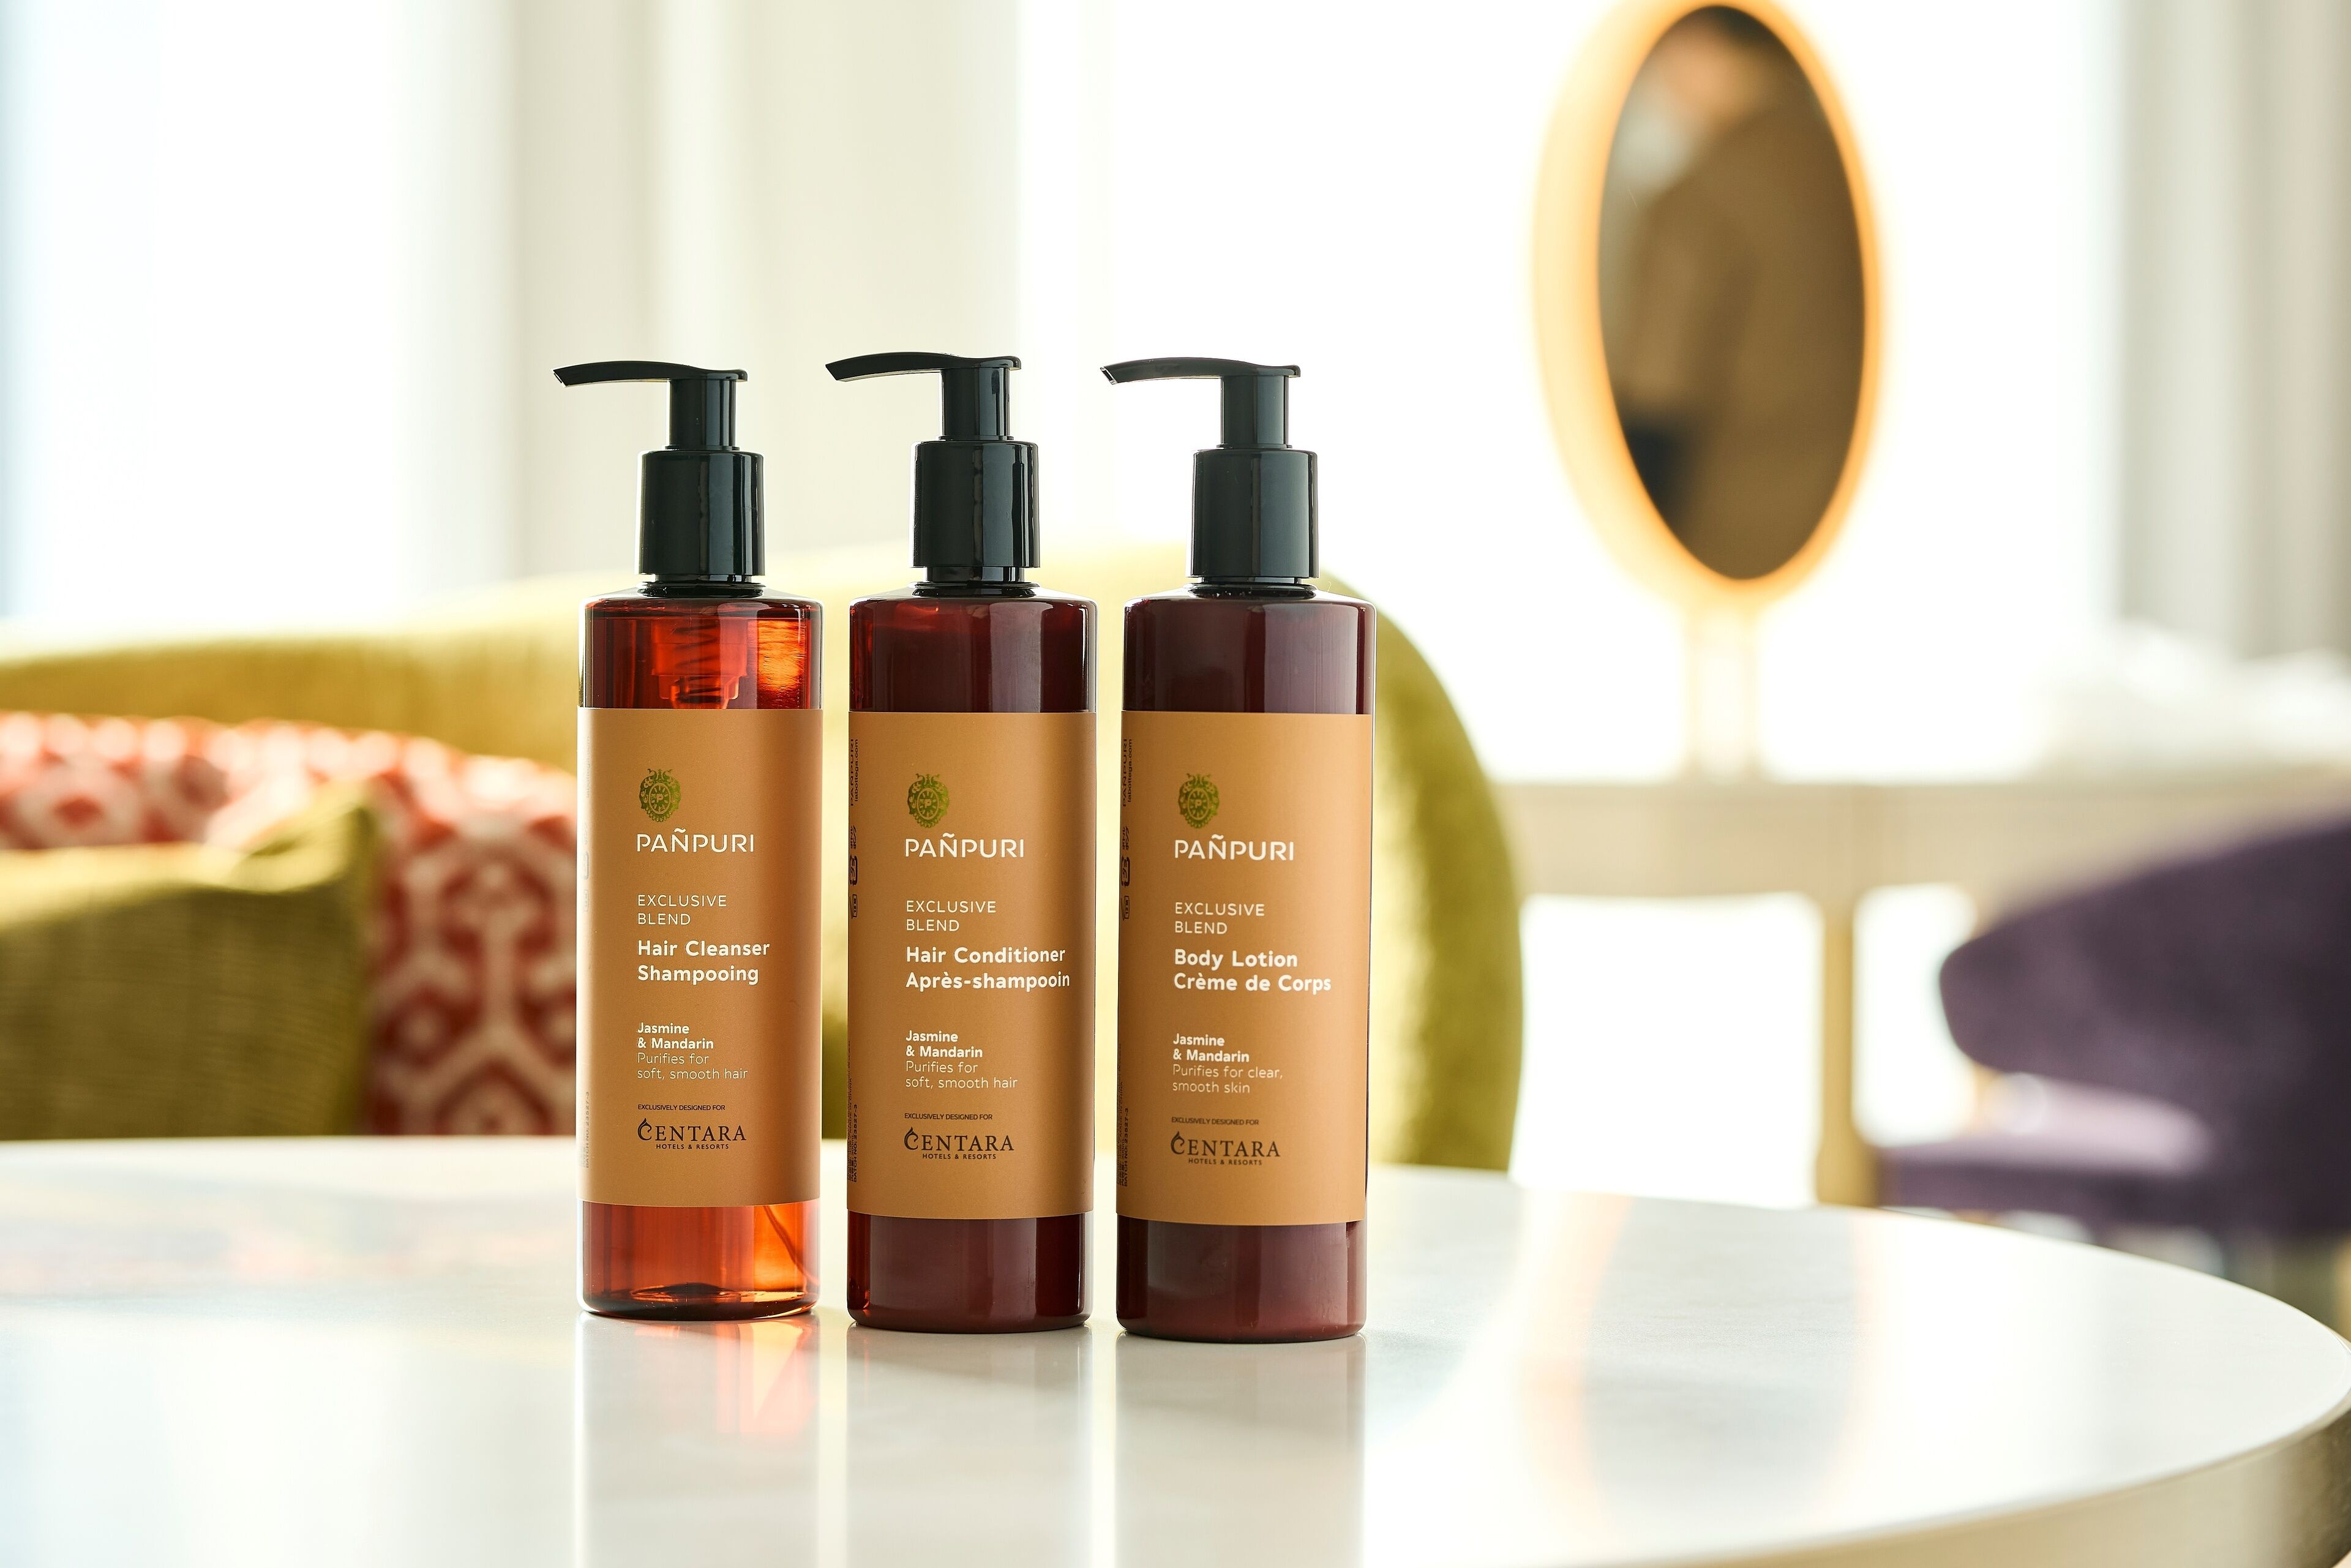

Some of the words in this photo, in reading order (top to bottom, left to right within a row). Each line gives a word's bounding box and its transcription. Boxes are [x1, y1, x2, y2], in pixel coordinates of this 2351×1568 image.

[637, 828, 753, 852] PAÑPURI
[906, 833, 1024, 858] PAÑPURI
[1175, 834, 1293, 860] PAÑPURI
[639, 895, 726, 906] EXCLUSIVE
[907, 901, 996, 913] EXCLUSIVE
[1176, 902, 1264, 916] EXCLUSIVE
[639, 913, 690, 925] BLEND
[907, 919, 959, 931] BLEND
[1176, 921, 1227, 934] BLEND
[637, 940, 677, 955] Hair
[686, 940, 770, 956] Cleanser
[907, 947, 946, 962] Hair
[954, 947, 1065, 963] Conditioner
[1175, 949, 1223, 970] Body
[1232, 950, 1297, 967] Lotion
[638, 965, 758, 985] Shampooing
[906, 971, 1069, 992] Après-shampooin
[1174, 973, 1237, 991] Crème
[1245, 975, 1270, 991] de
[1278, 975, 1330, 994] Corps
[638, 1022, 689, 1033] Jasmine
[906, 1030, 958, 1042] Jasmine
[1173, 1033, 1224, 1046] Jasmine
[638, 1037, 646, 1048] &
[652, 1038, 713, 1049] Mandarin
[638, 1052, 684, 1063] Purifies
[689, 1053, 709, 1063] for
[906, 1045, 915, 1056] &
[920, 1046, 983, 1057] Mandarin
[1173, 1049, 1182, 1060] &
[1187, 1049, 1249, 1062] Mandarin
[907, 1060, 953, 1073] Purifies
[958, 1062, 978, 1073] for
[1173, 1064, 1218, 1077] Purifies
[1223, 1066, 1243, 1078] for
[1248, 1067, 1282, 1079] clear,
[638, 1068, 664, 1080] soft,
[670, 1068, 719, 1079] smooth
[725, 1068, 748, 1079] hair
[906, 1076, 932, 1089] soft,
[939, 1077, 988, 1088] smooth
[994, 1077, 1018, 1088] hair
[1173, 1081, 1219, 1092] smooth
[1224, 1082, 1250, 1093] skin
[638, 1118, 746, 1141] CENTARA
[904, 1127, 1014, 1151] CENTARA
[1171, 1131, 1280, 1157] CENTARA
